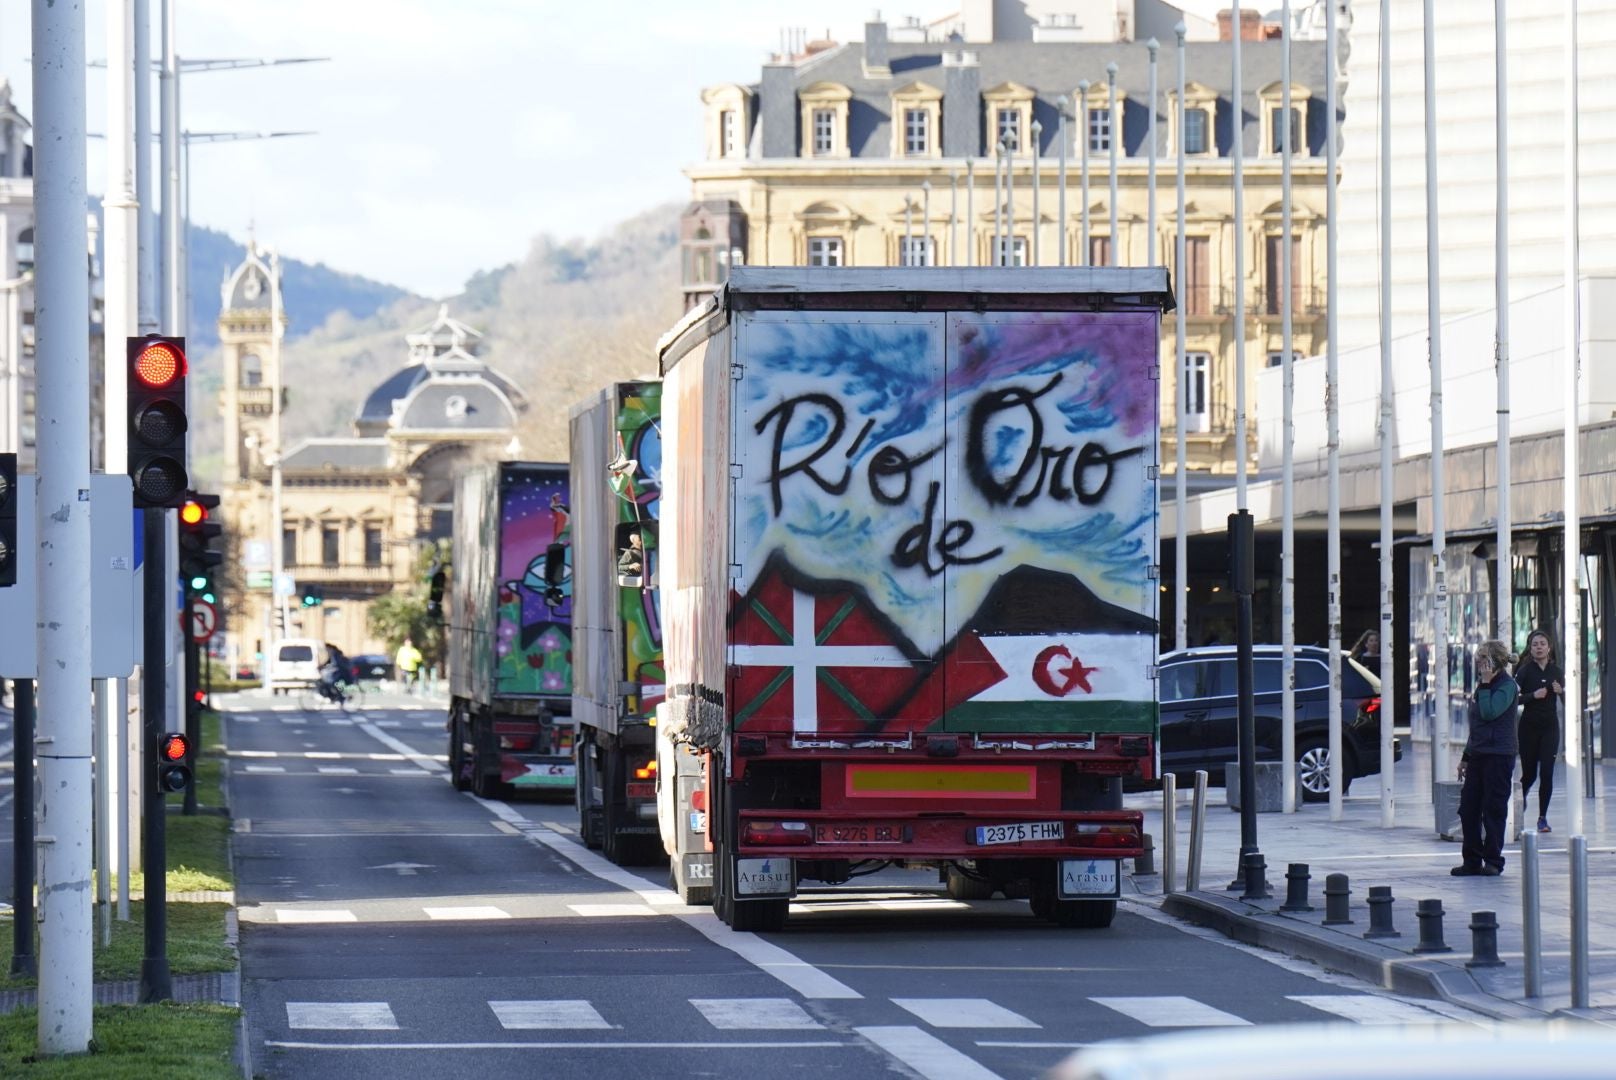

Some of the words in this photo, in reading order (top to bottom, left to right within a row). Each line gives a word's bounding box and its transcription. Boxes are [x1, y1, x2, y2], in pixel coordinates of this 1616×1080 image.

[890, 481, 1004, 578] de
[965, 372, 1147, 508] Oro
[816, 826, 826, 841] R
[987, 825, 1026, 842] 2375
[1031, 823, 1061, 839] FHM
[739, 871, 790, 883] Arasur
[1064, 871, 1115, 883] Arasur
